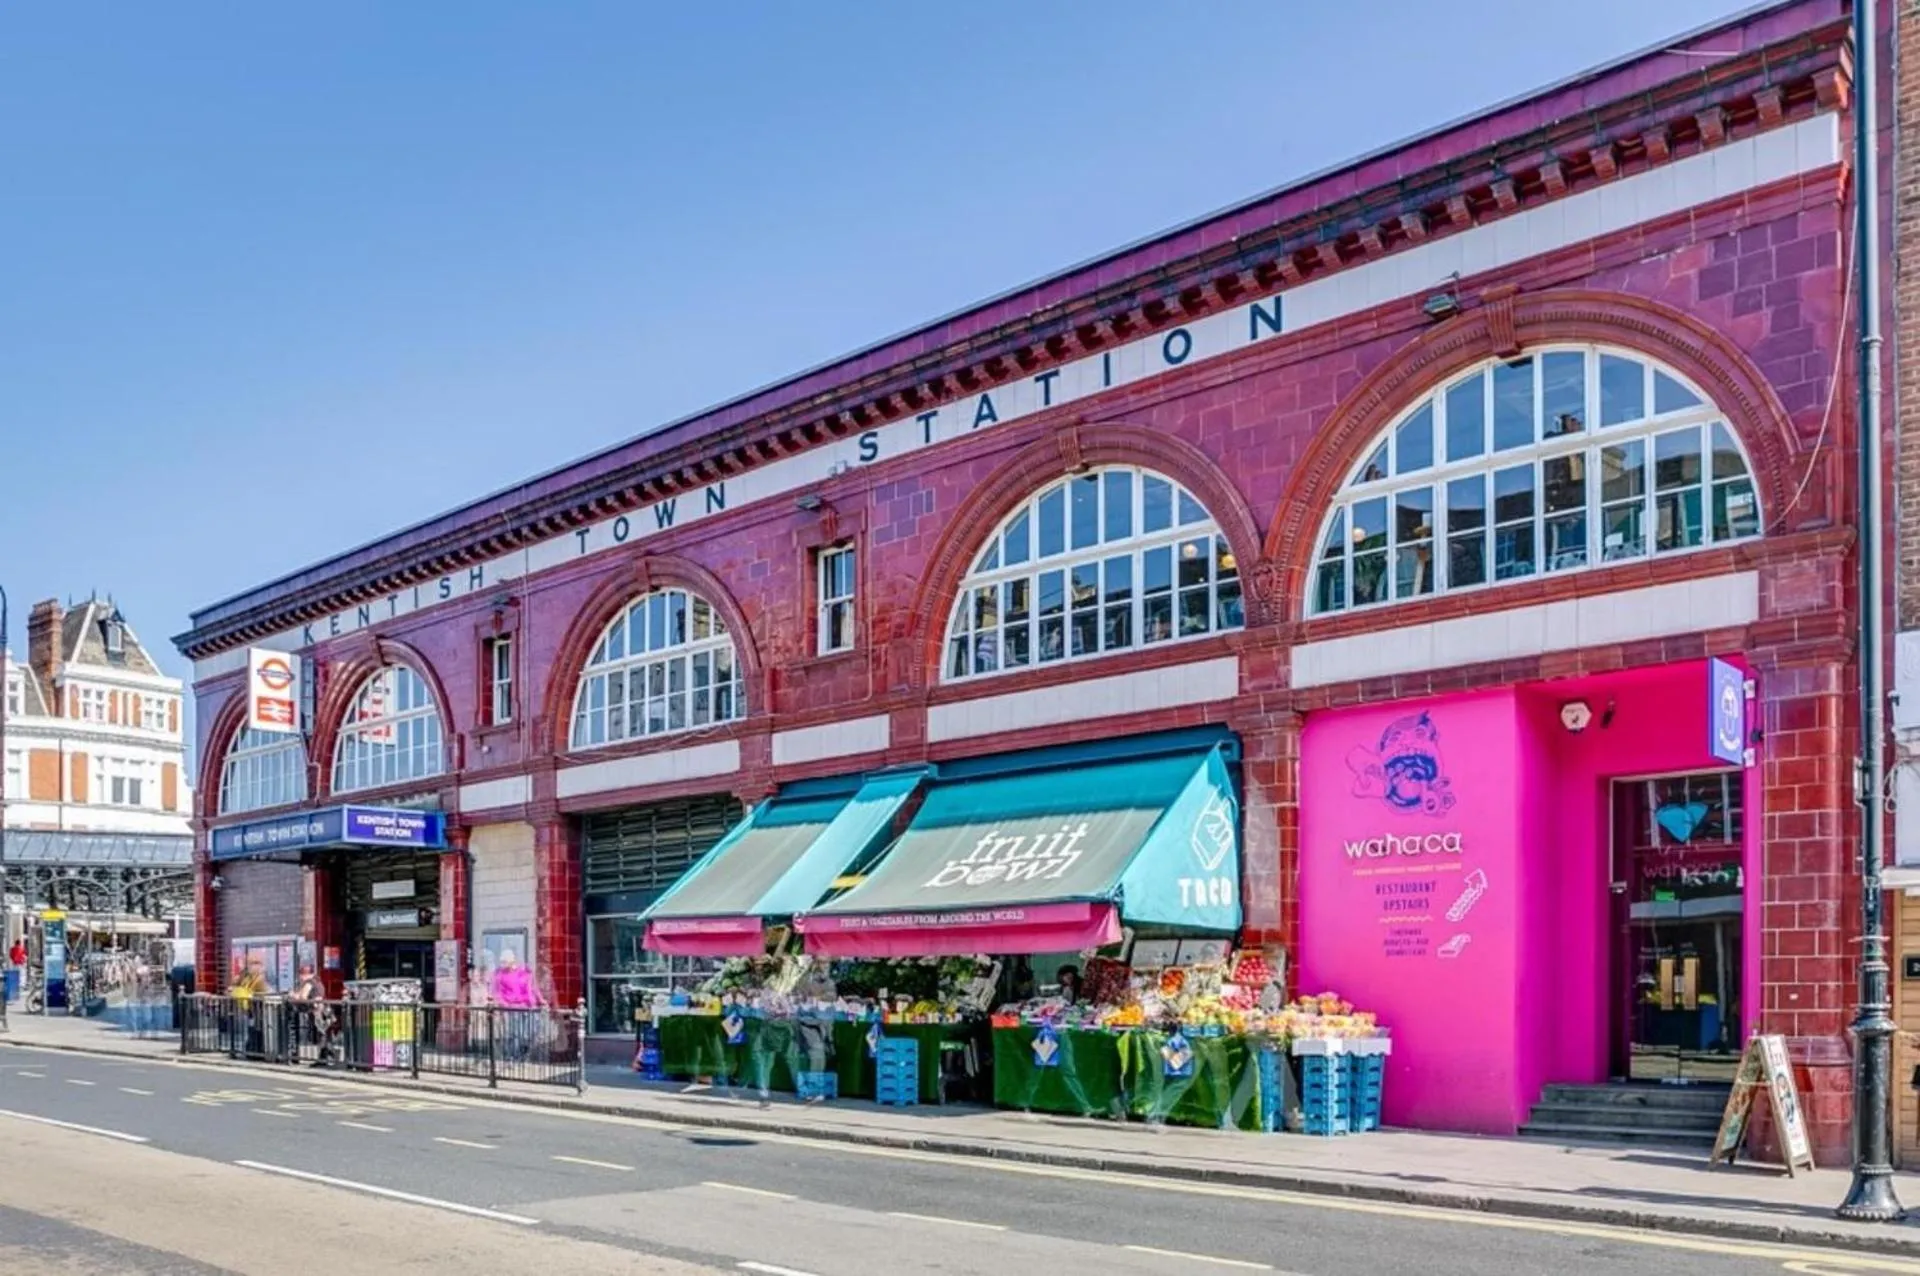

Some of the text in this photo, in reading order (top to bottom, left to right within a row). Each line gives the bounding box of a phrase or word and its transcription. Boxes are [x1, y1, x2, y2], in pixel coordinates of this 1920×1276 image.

[303, 295, 1283, 643] KENTISH TOWN STATION
[356, 814, 426, 830] KENTISH TOWN
[374, 826, 412, 838] STATION
[960, 822, 1089, 863] fruit
[1343, 832, 1463, 858] wahaca
[921, 850, 1084, 888] bowl
[1177, 877, 1232, 909] TACO
[1375, 881, 1436, 895] RESTAURANT
[1383, 897, 1430, 911] UPSTAIRS
[991, 910, 1025, 921] WORLD
